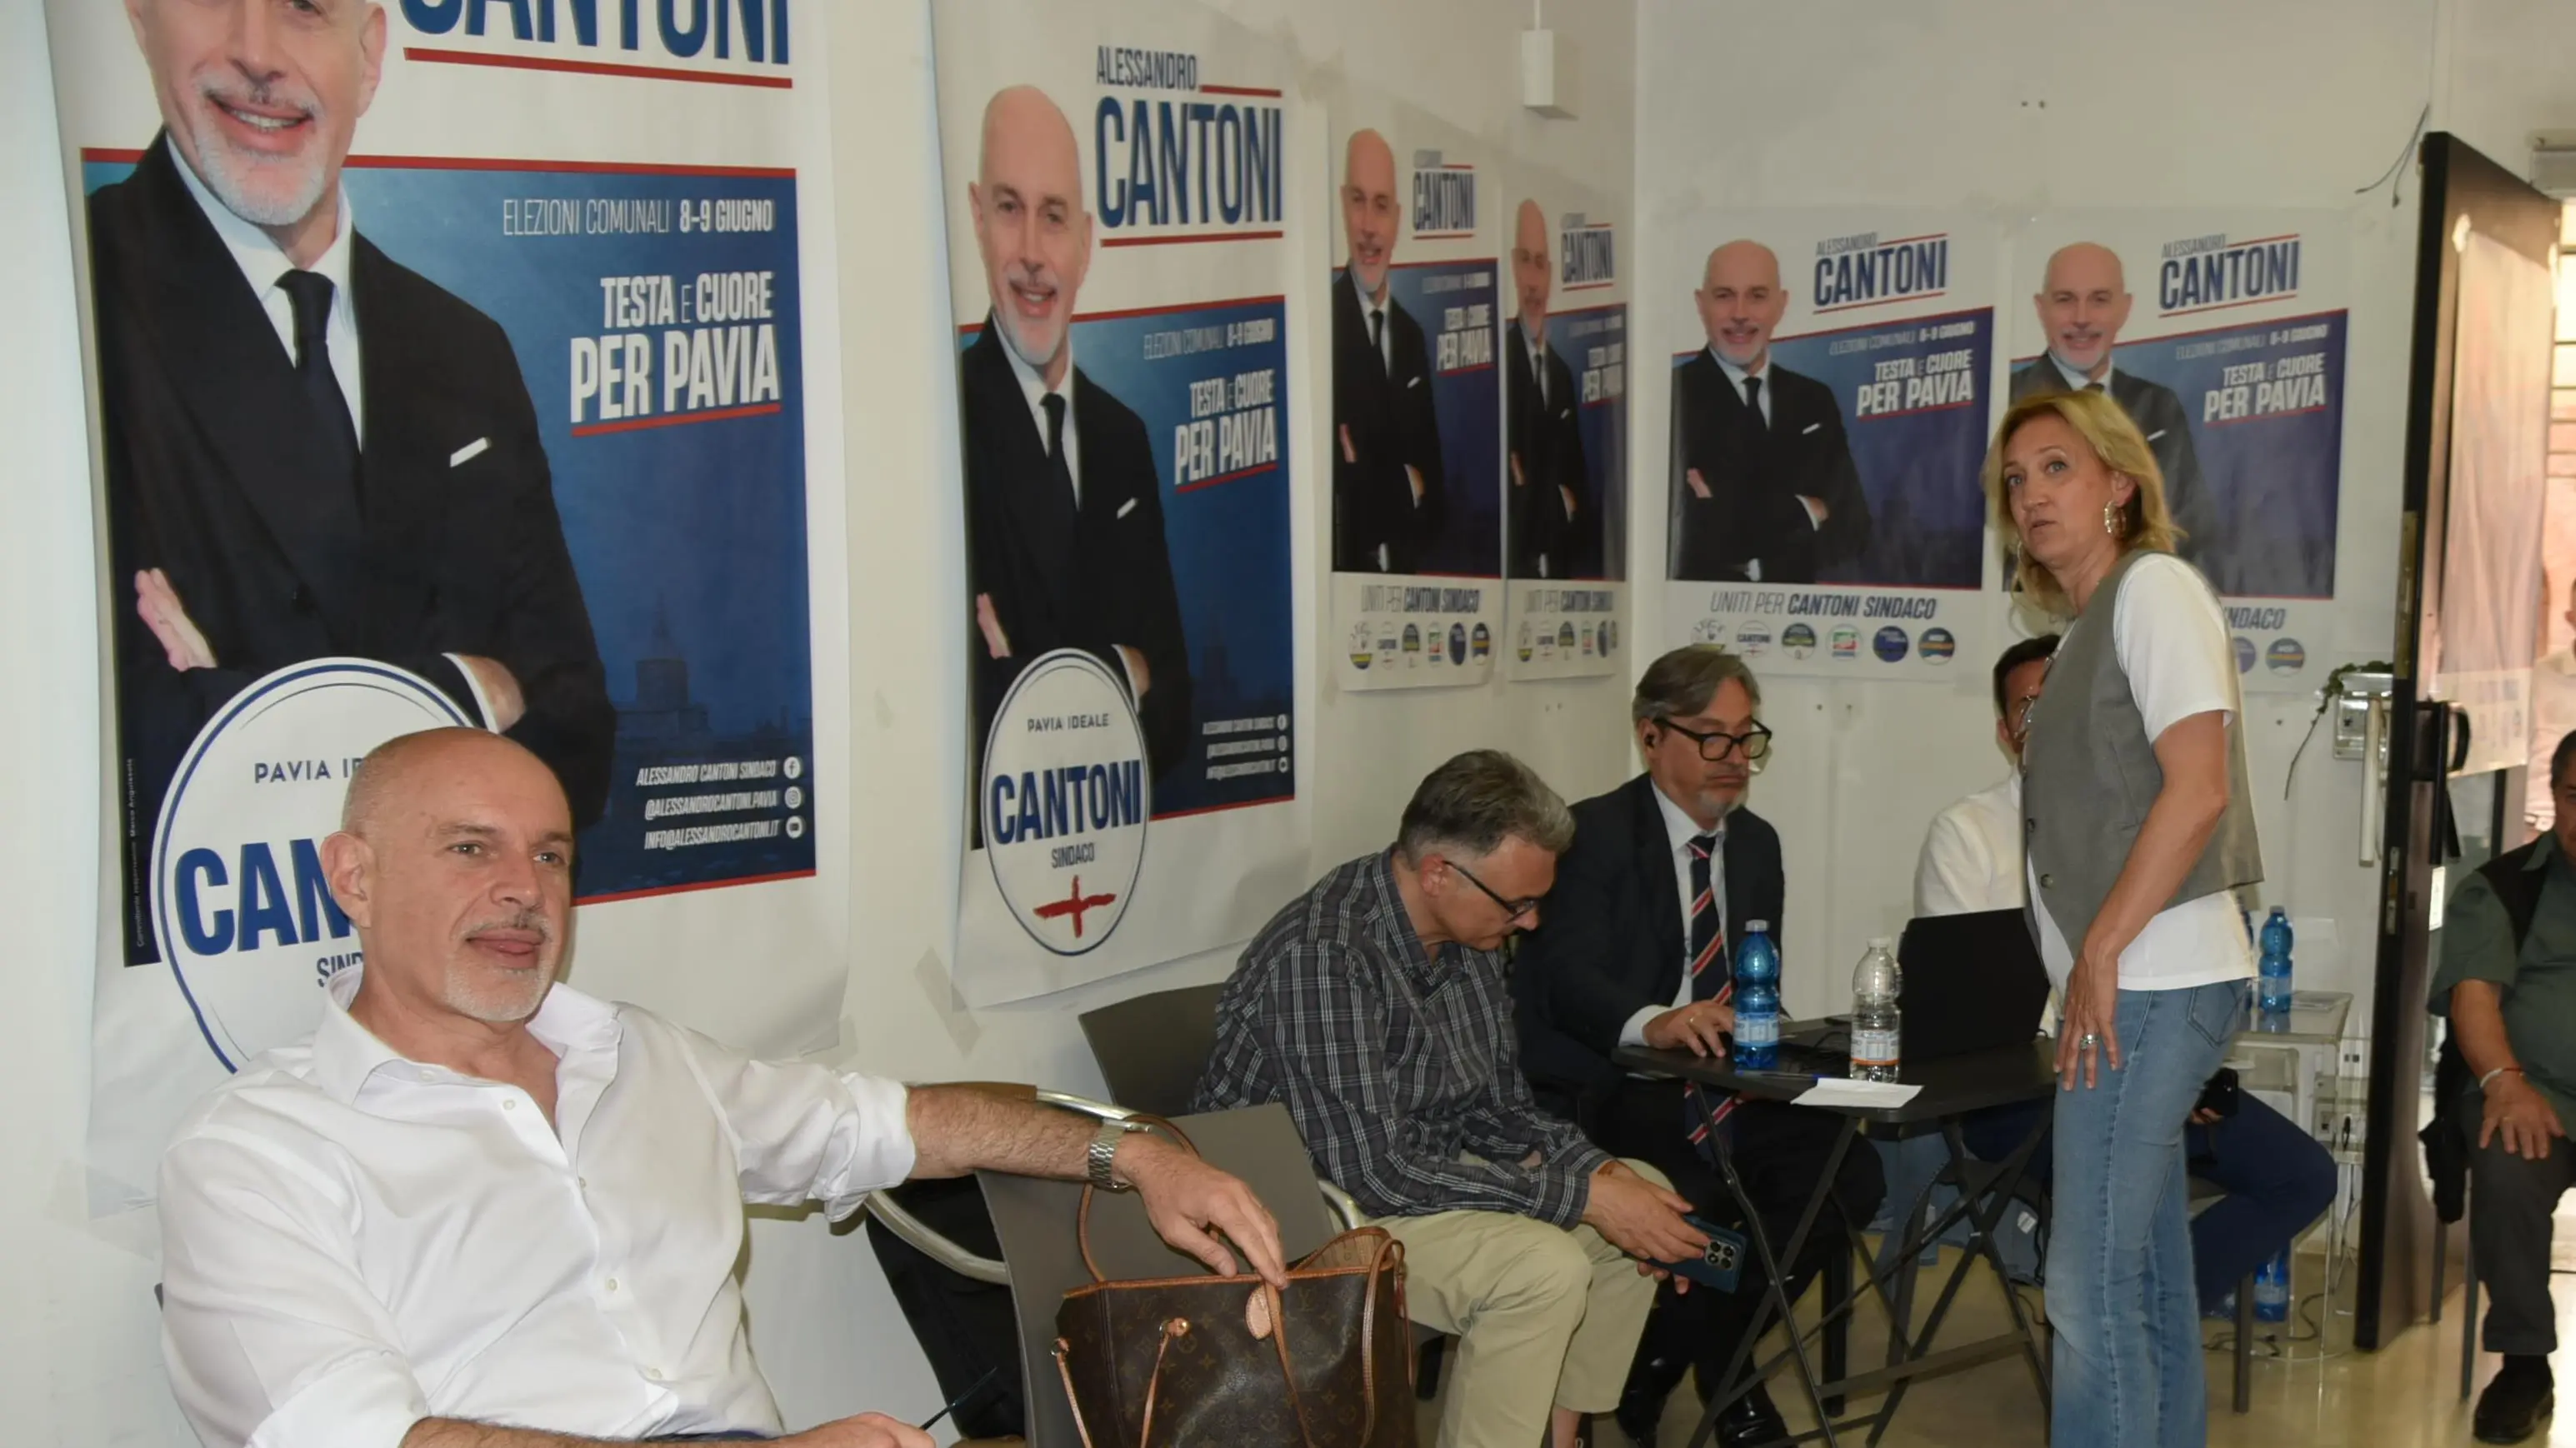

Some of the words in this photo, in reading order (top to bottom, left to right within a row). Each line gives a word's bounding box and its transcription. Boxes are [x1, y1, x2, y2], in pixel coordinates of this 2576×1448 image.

[1097, 45, 1197, 90] ALESSANDRO
[1095, 96, 1281, 228] CANTONI
[503, 199, 579, 236] ELEZIONI
[586, 199, 669, 234] COMUNALI
[680, 199, 710, 233] 8-9
[715, 198, 774, 232] GIUGNO
[1814, 240, 1947, 307] CANTONI
[2159, 241, 2299, 310] CANTONI
[600, 275, 675, 328] TESTA
[682, 285, 693, 323] E
[696, 271, 773, 323] CUORE
[571, 333, 651, 423] PER
[663, 324, 780, 412] PAVIA
[1874, 358, 1914, 382] TESTA
[1926, 348, 1973, 374] CUORE
[2223, 362, 2265, 387] TESTA
[2277, 352, 2326, 378] CUORE
[1189, 377, 1225, 418] TESTA
[1235, 368, 1274, 409] CUORE
[1857, 381, 1900, 417] PER
[1905, 369, 1973, 409] PAVIA
[2203, 386, 2249, 422] PER
[2255, 373, 2326, 415] PAVIA
[1175, 419, 1214, 485] PER
[1218, 407, 1278, 473] PAVIA
[1710, 591, 1752, 613] UNITI
[1754, 592, 1784, 614] PER
[1788, 593, 1860, 617] CANTONI
[1863, 597, 1936, 620] SINDACO
[1028, 717, 1063, 733] PAVIA
[1068, 714, 1110, 730] IDEALE
[254, 760, 332, 783] PAVIA
[635, 765, 698, 786] ALESSANDRO
[700, 762, 738, 782] CANTONI
[739, 760, 776, 779] SINDACO
[990, 759, 1141, 845] CANTONI
[1052, 842, 1095, 869] SINDACO
